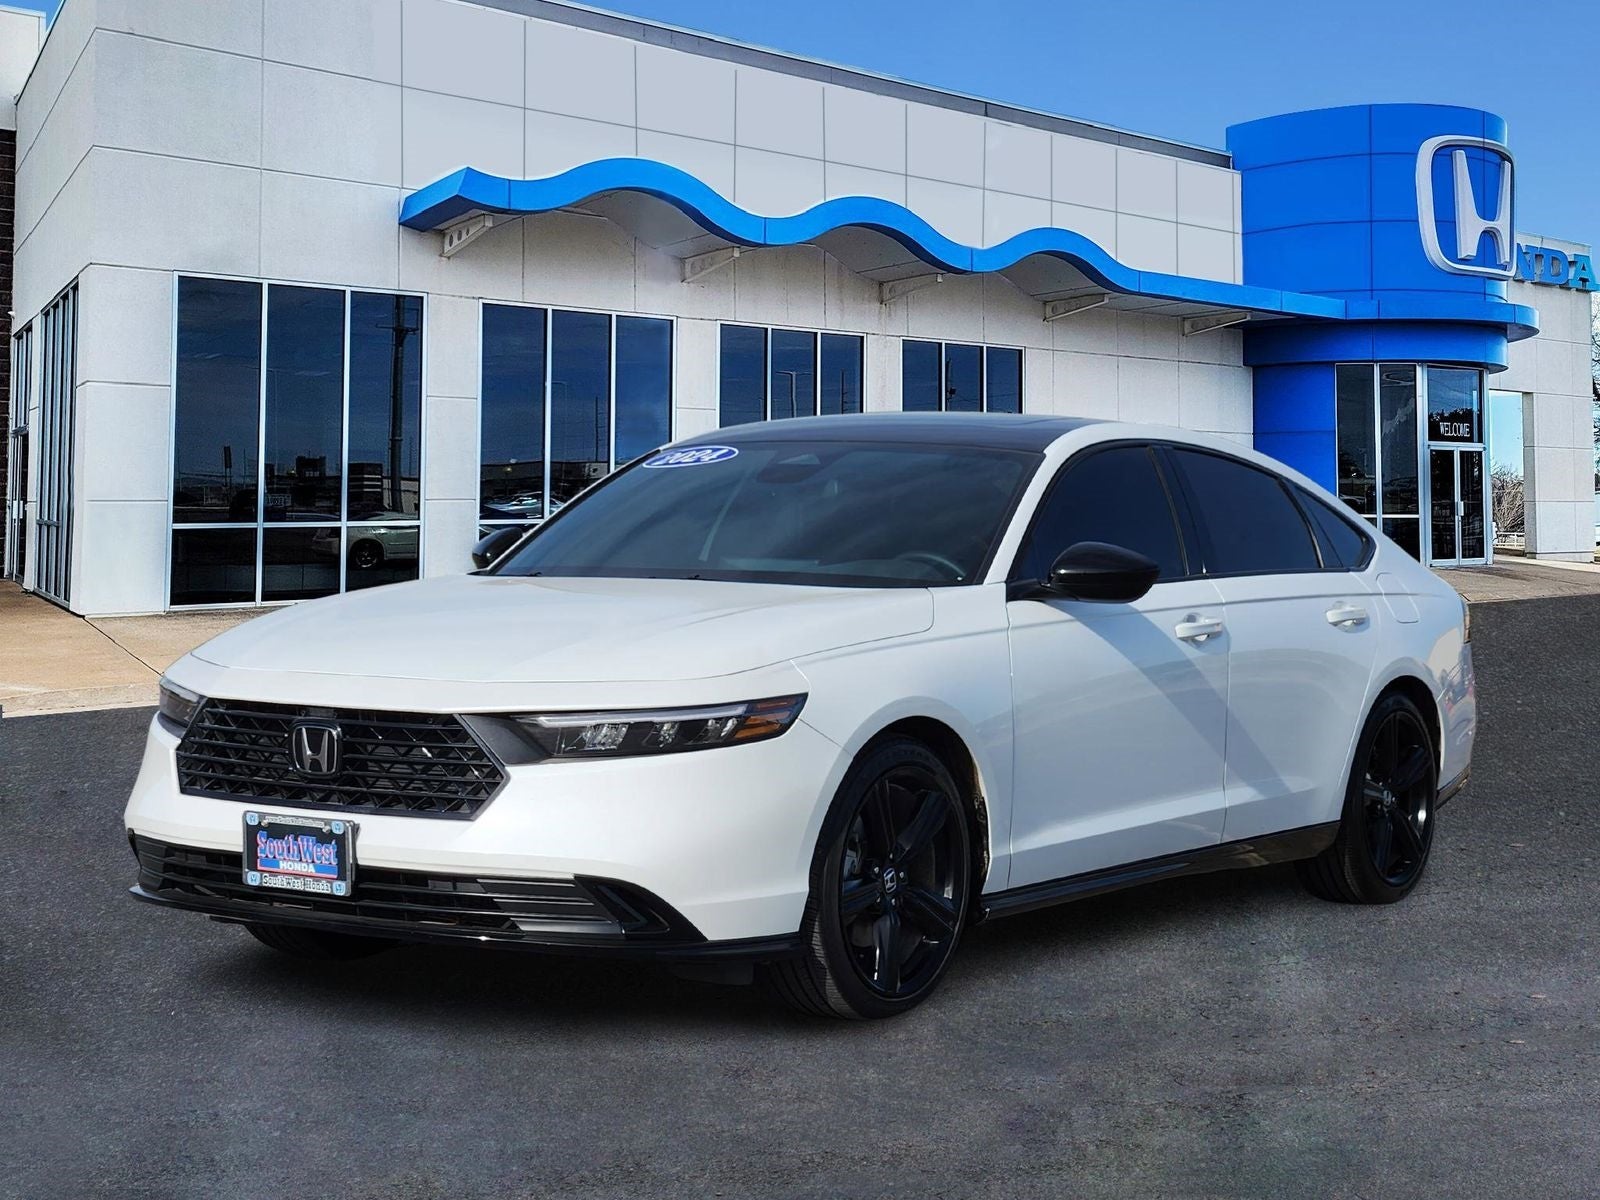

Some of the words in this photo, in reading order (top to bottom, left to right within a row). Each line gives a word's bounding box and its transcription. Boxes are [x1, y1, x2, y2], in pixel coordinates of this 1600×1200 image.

[1439, 422, 1471, 438] WELCOME
[279, 860, 316, 873] HONDA
[304, 879, 331, 893] Honda
